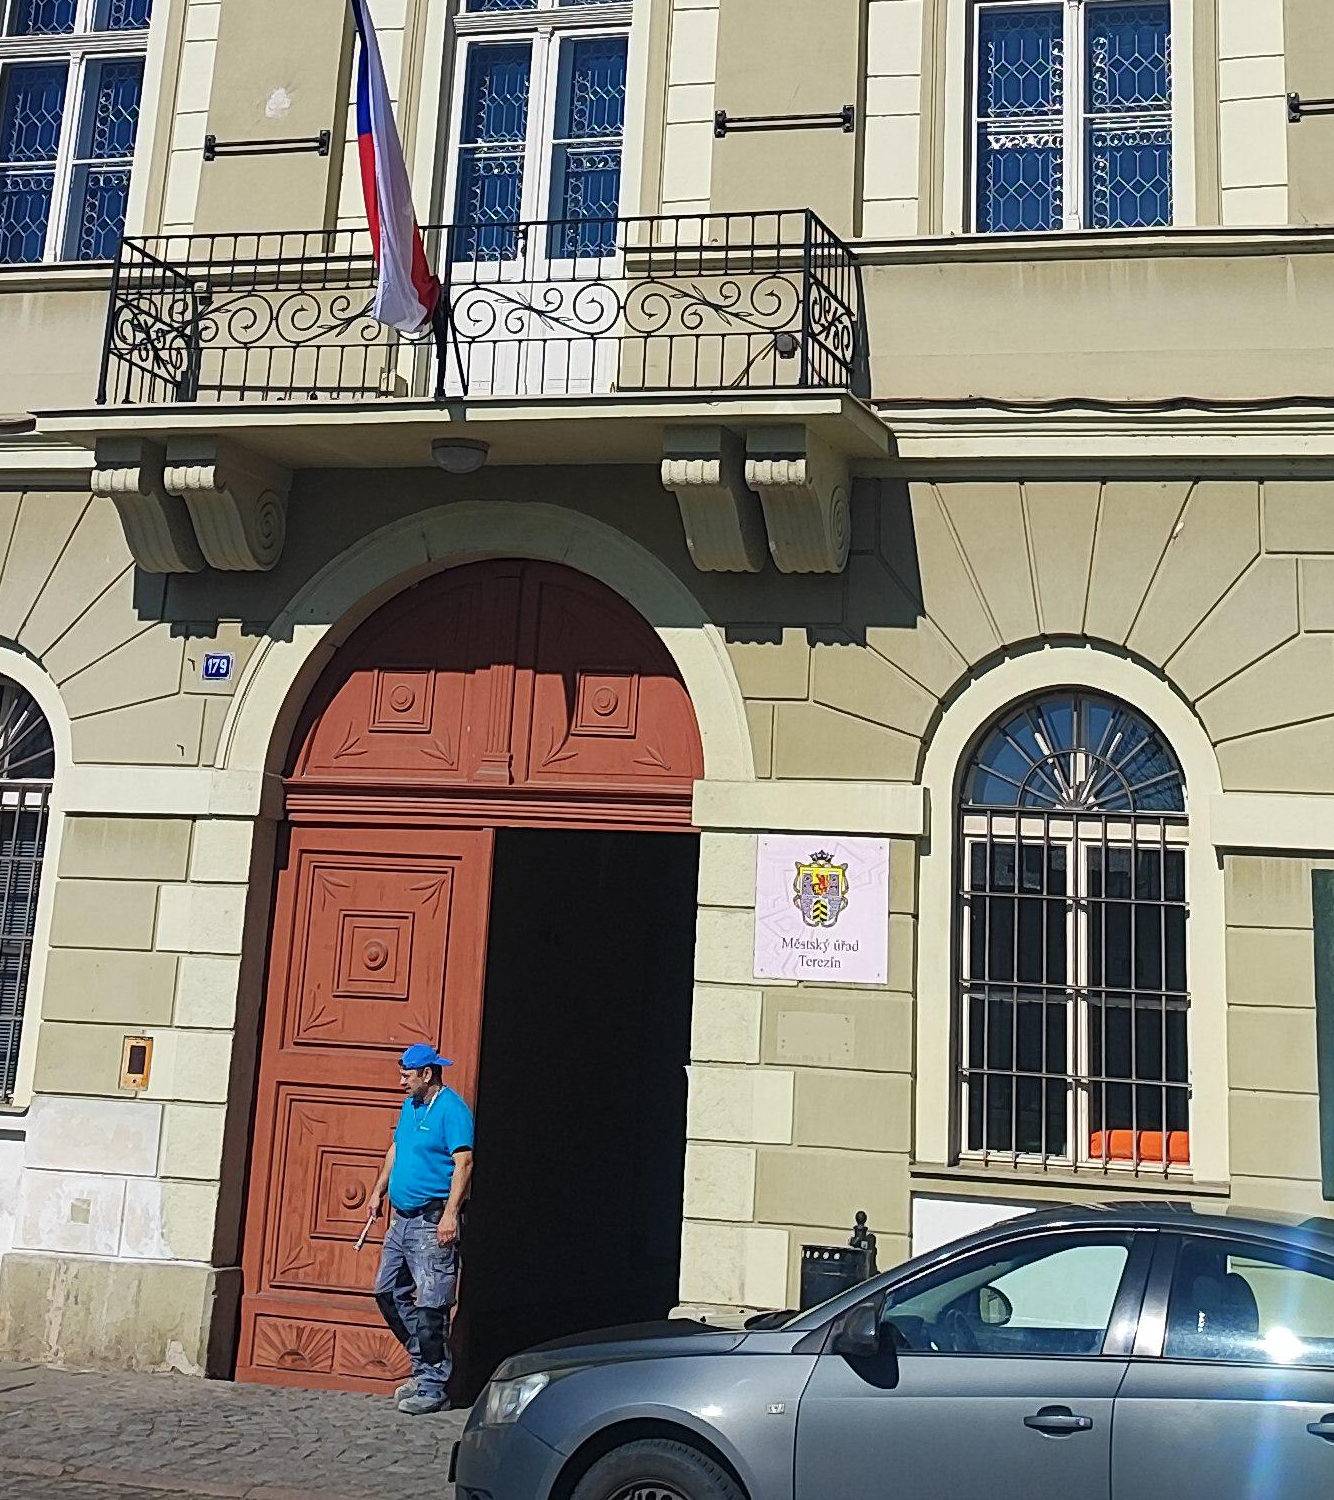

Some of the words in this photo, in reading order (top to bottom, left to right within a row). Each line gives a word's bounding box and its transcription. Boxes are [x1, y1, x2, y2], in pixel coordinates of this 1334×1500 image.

[207, 658, 228, 674] 179
[781, 937, 830, 954] Městský
[833, 939, 859, 953] úřad
[798, 954, 841, 969] Terezín
